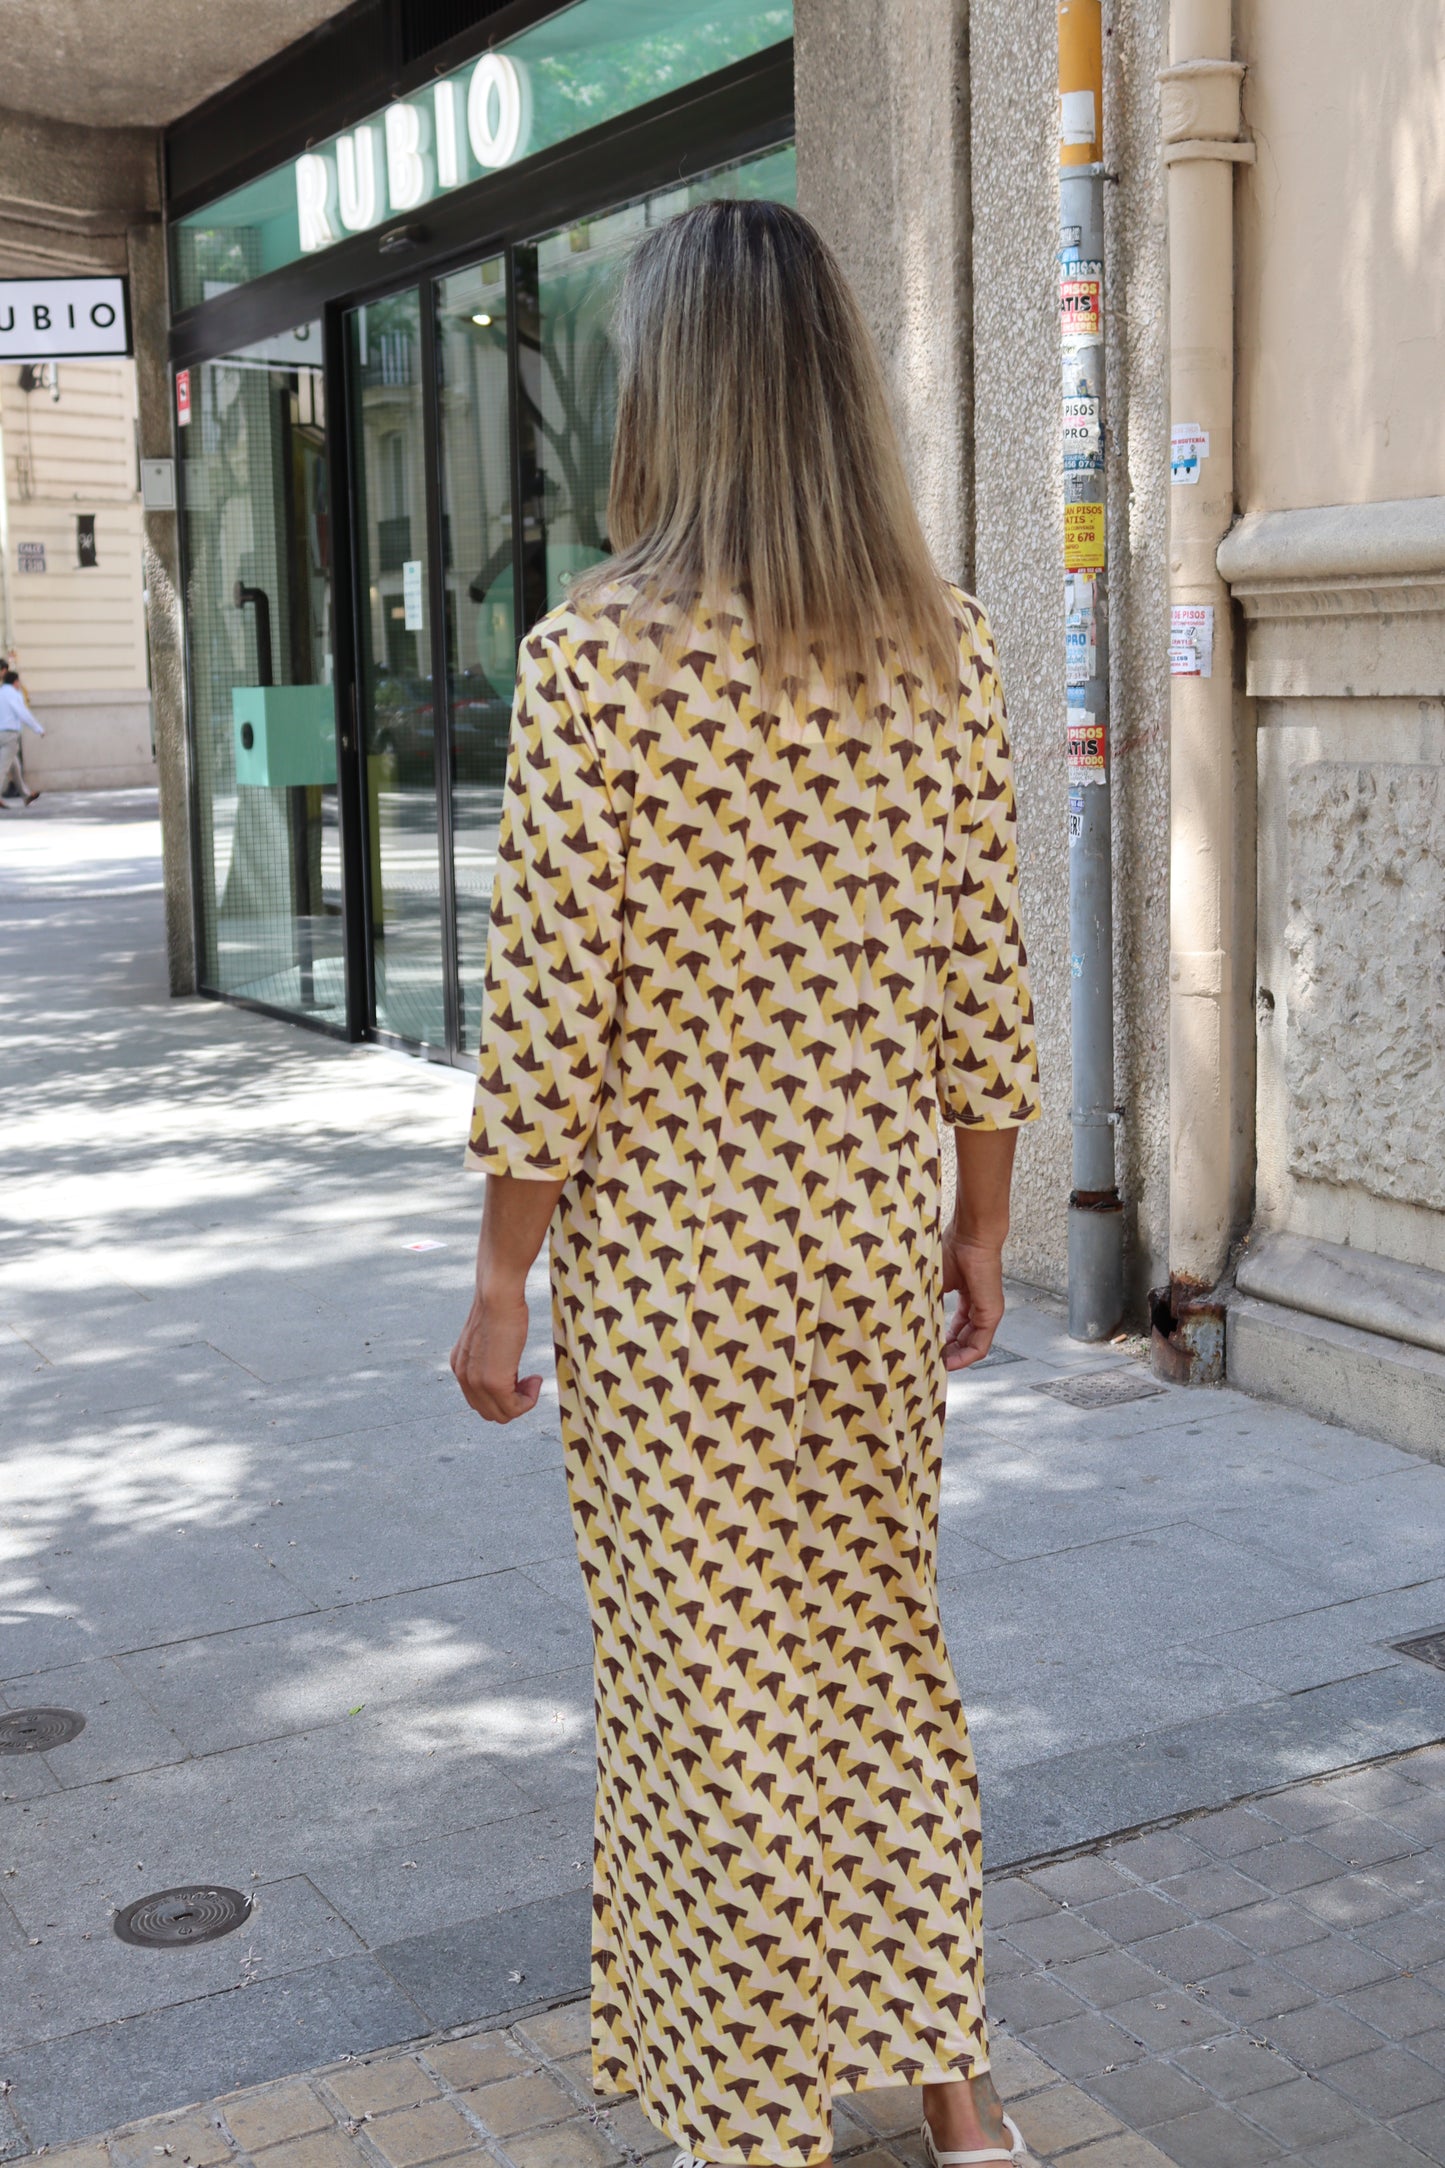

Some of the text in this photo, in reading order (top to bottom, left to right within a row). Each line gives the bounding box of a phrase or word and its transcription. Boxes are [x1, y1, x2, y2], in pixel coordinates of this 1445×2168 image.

[295, 53, 523, 252] RUBIO
[1063, 283, 1097, 295] PISOS
[0, 303, 116, 331] UBIO
[1065, 404, 1095, 416] PISOS
[1076, 505, 1103, 515] PISOS
[1077, 532, 1096, 543] 678
[1182, 610, 1206, 619] PISOS
[1070, 727, 1104, 739] PISOS
[1080, 756, 1104, 765] TODO
